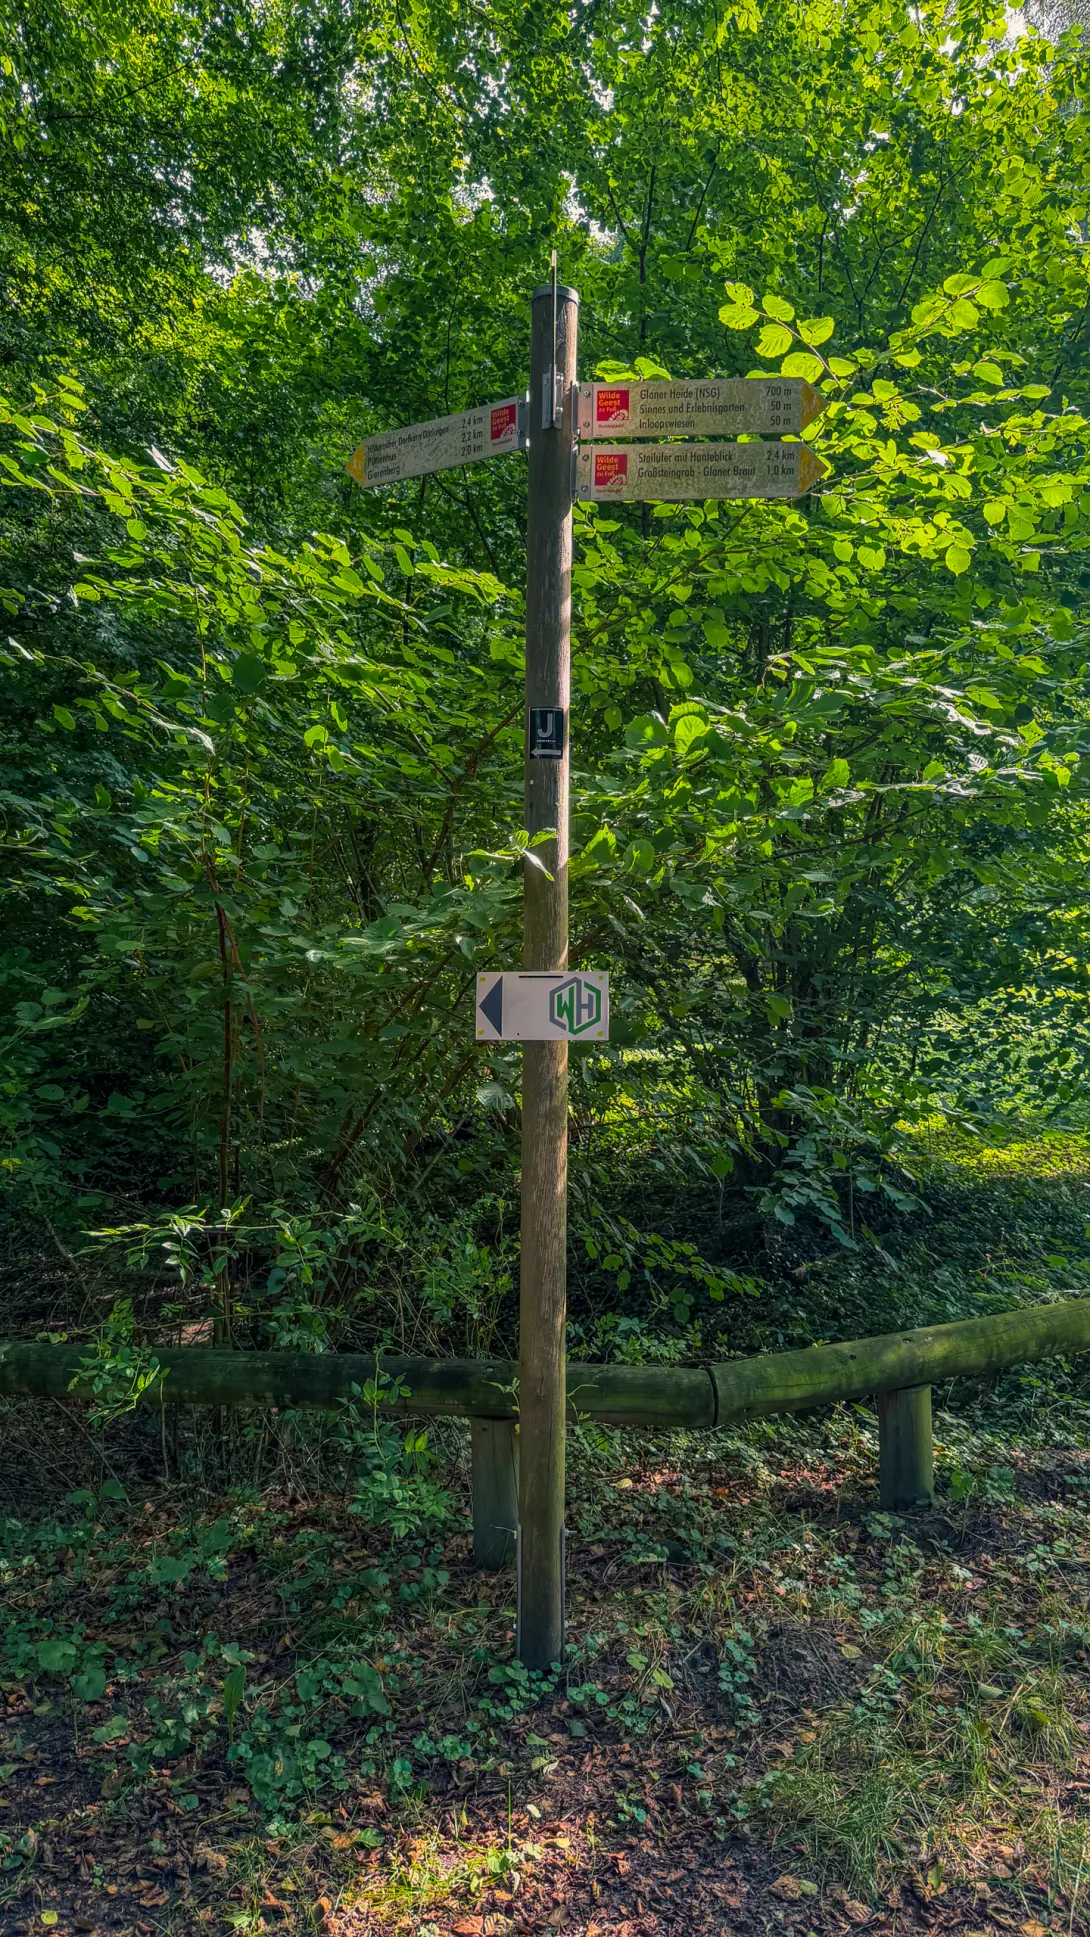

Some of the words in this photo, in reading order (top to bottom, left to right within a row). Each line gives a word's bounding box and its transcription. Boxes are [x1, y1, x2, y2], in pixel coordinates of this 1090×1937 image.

[640, 390, 667, 400] Glaner
[670, 390, 693, 399] Heide
[696, 388, 720, 400] (NSG)
[766, 386, 781, 396] 700
[640, 404, 666, 414] Sinnes
[669, 405, 684, 414] und
[686, 402, 745, 414] Erlebnisgarten
[770, 401, 781, 411] 50
[462, 418, 471, 429] 2,4
[473, 416, 483, 425] km
[639, 418, 695, 429] Inloopswiesen
[770, 416, 781, 426] 50
[398, 433, 422, 448] Dorfkern
[462, 432, 471, 443] 2,2
[473, 430, 483, 439] km
[462, 446, 471, 457] 2,0
[472, 444, 483, 453] km
[767, 451, 779, 462] 2,4
[782, 450, 794, 460] km
[639, 453, 672, 463] Steilufer
[675, 452, 688, 462] mit
[690, 452, 733, 462] Hunteblick
[638, 466, 695, 479] Großsteingrab
[704, 467, 731, 476] Glaner
[734, 467, 756, 476] Braut
[766, 466, 779, 476] 1,0
[782, 465, 794, 475] km
[537, 713, 553, 737] J
